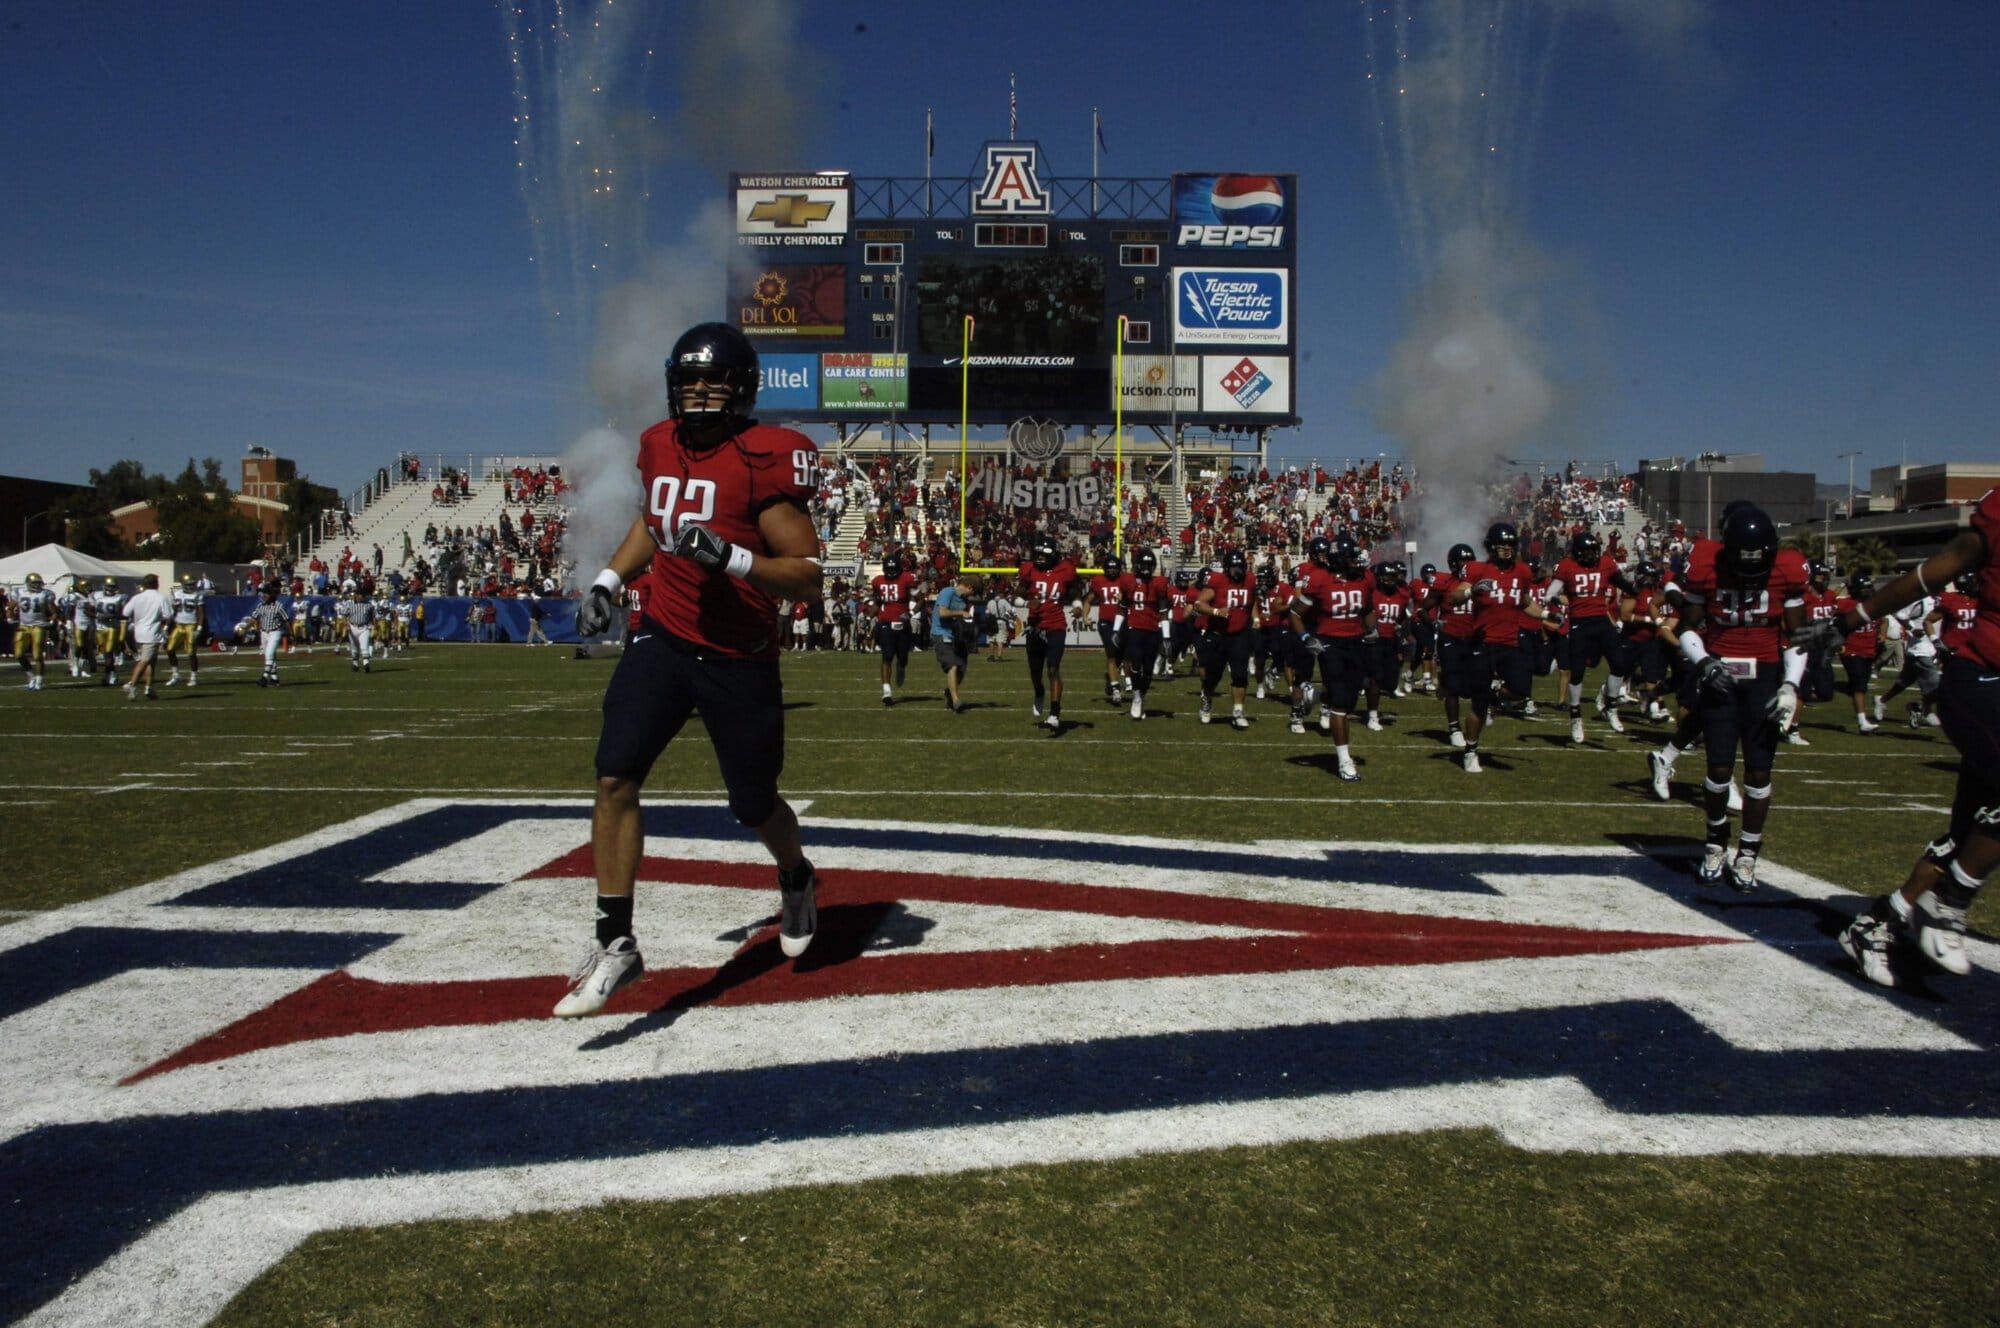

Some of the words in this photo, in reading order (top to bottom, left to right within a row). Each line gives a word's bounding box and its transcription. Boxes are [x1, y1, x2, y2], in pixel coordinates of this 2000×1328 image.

[740, 177, 782, 187] WATSON
[784, 176, 844, 187] CHEVROLET
[975, 149, 1047, 211] A
[738, 236, 781, 246] O'RIELLY
[783, 235, 844, 246] CHEVROLET
[936, 230, 954, 240] TOL
[1069, 231, 1087, 241] TOL
[1177, 225, 1285, 249] PEPSI
[1204, 278, 1258, 292] Tucson
[1210, 293, 1272, 308] Electric
[741, 306, 768, 325] DEL
[772, 306, 798, 325] SOL
[1216, 307, 1272, 321] Power
[1178, 331, 1185, 340] A
[1222, 331, 1247, 341] Energy
[1247, 331, 1281, 341] Company
[824, 368, 842, 377] CAR
[844, 368, 866, 377] CARE
[1235, 373, 1266, 402] Domino's
[1240, 388, 1262, 410] Pizza
[791, 448, 819, 488] 92
[648, 474, 717, 553] 92
[879, 583, 900, 603] 33
[1034, 580, 1061, 605] 34
[1488, 577, 1522, 606] 44
[1574, 572, 1602, 599] 27
[19, 596, 42, 614] 31
[1100, 586, 1121, 606] 13
[1226, 588, 1249, 608] 67
[1330, 589, 1363, 620] 28
[1376, 602, 1402, 625] 30
